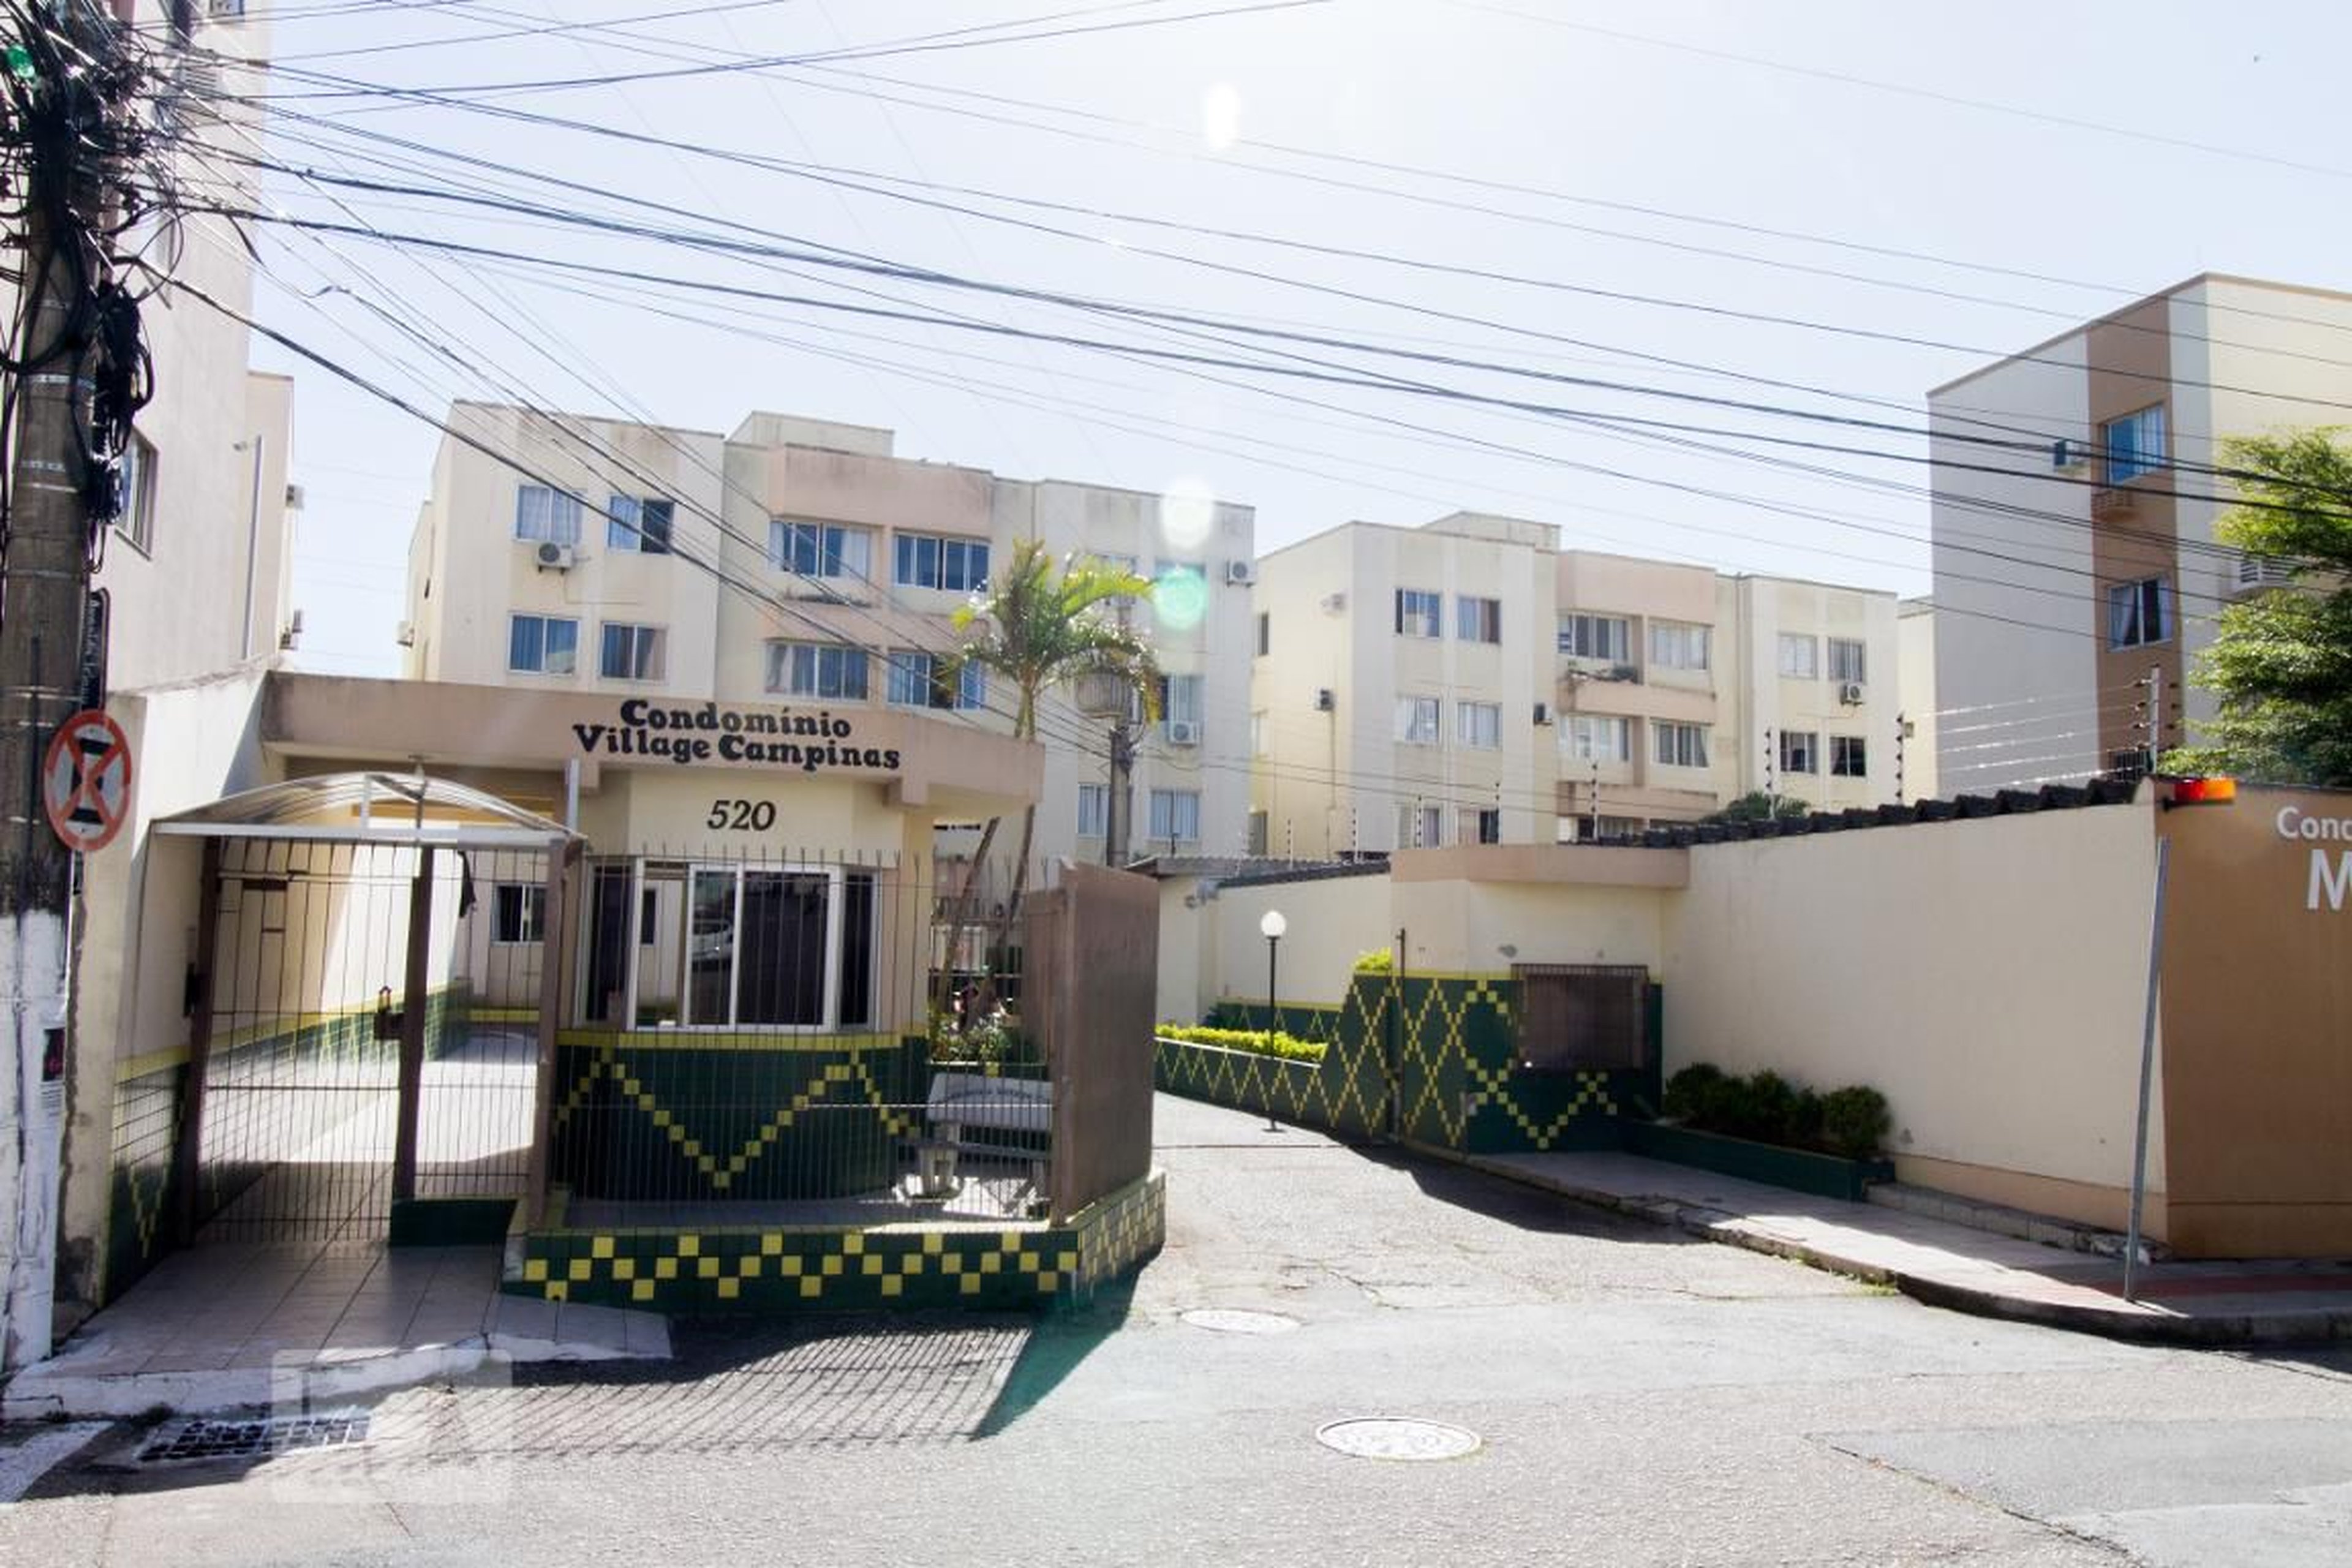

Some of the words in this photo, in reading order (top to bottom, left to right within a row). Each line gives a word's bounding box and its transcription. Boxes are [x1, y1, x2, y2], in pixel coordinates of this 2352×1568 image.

[620, 699, 851, 737] Condomínio
[573, 724, 710, 763] Village
[718, 735, 900, 771] Campinas
[707, 800, 775, 831] 520
